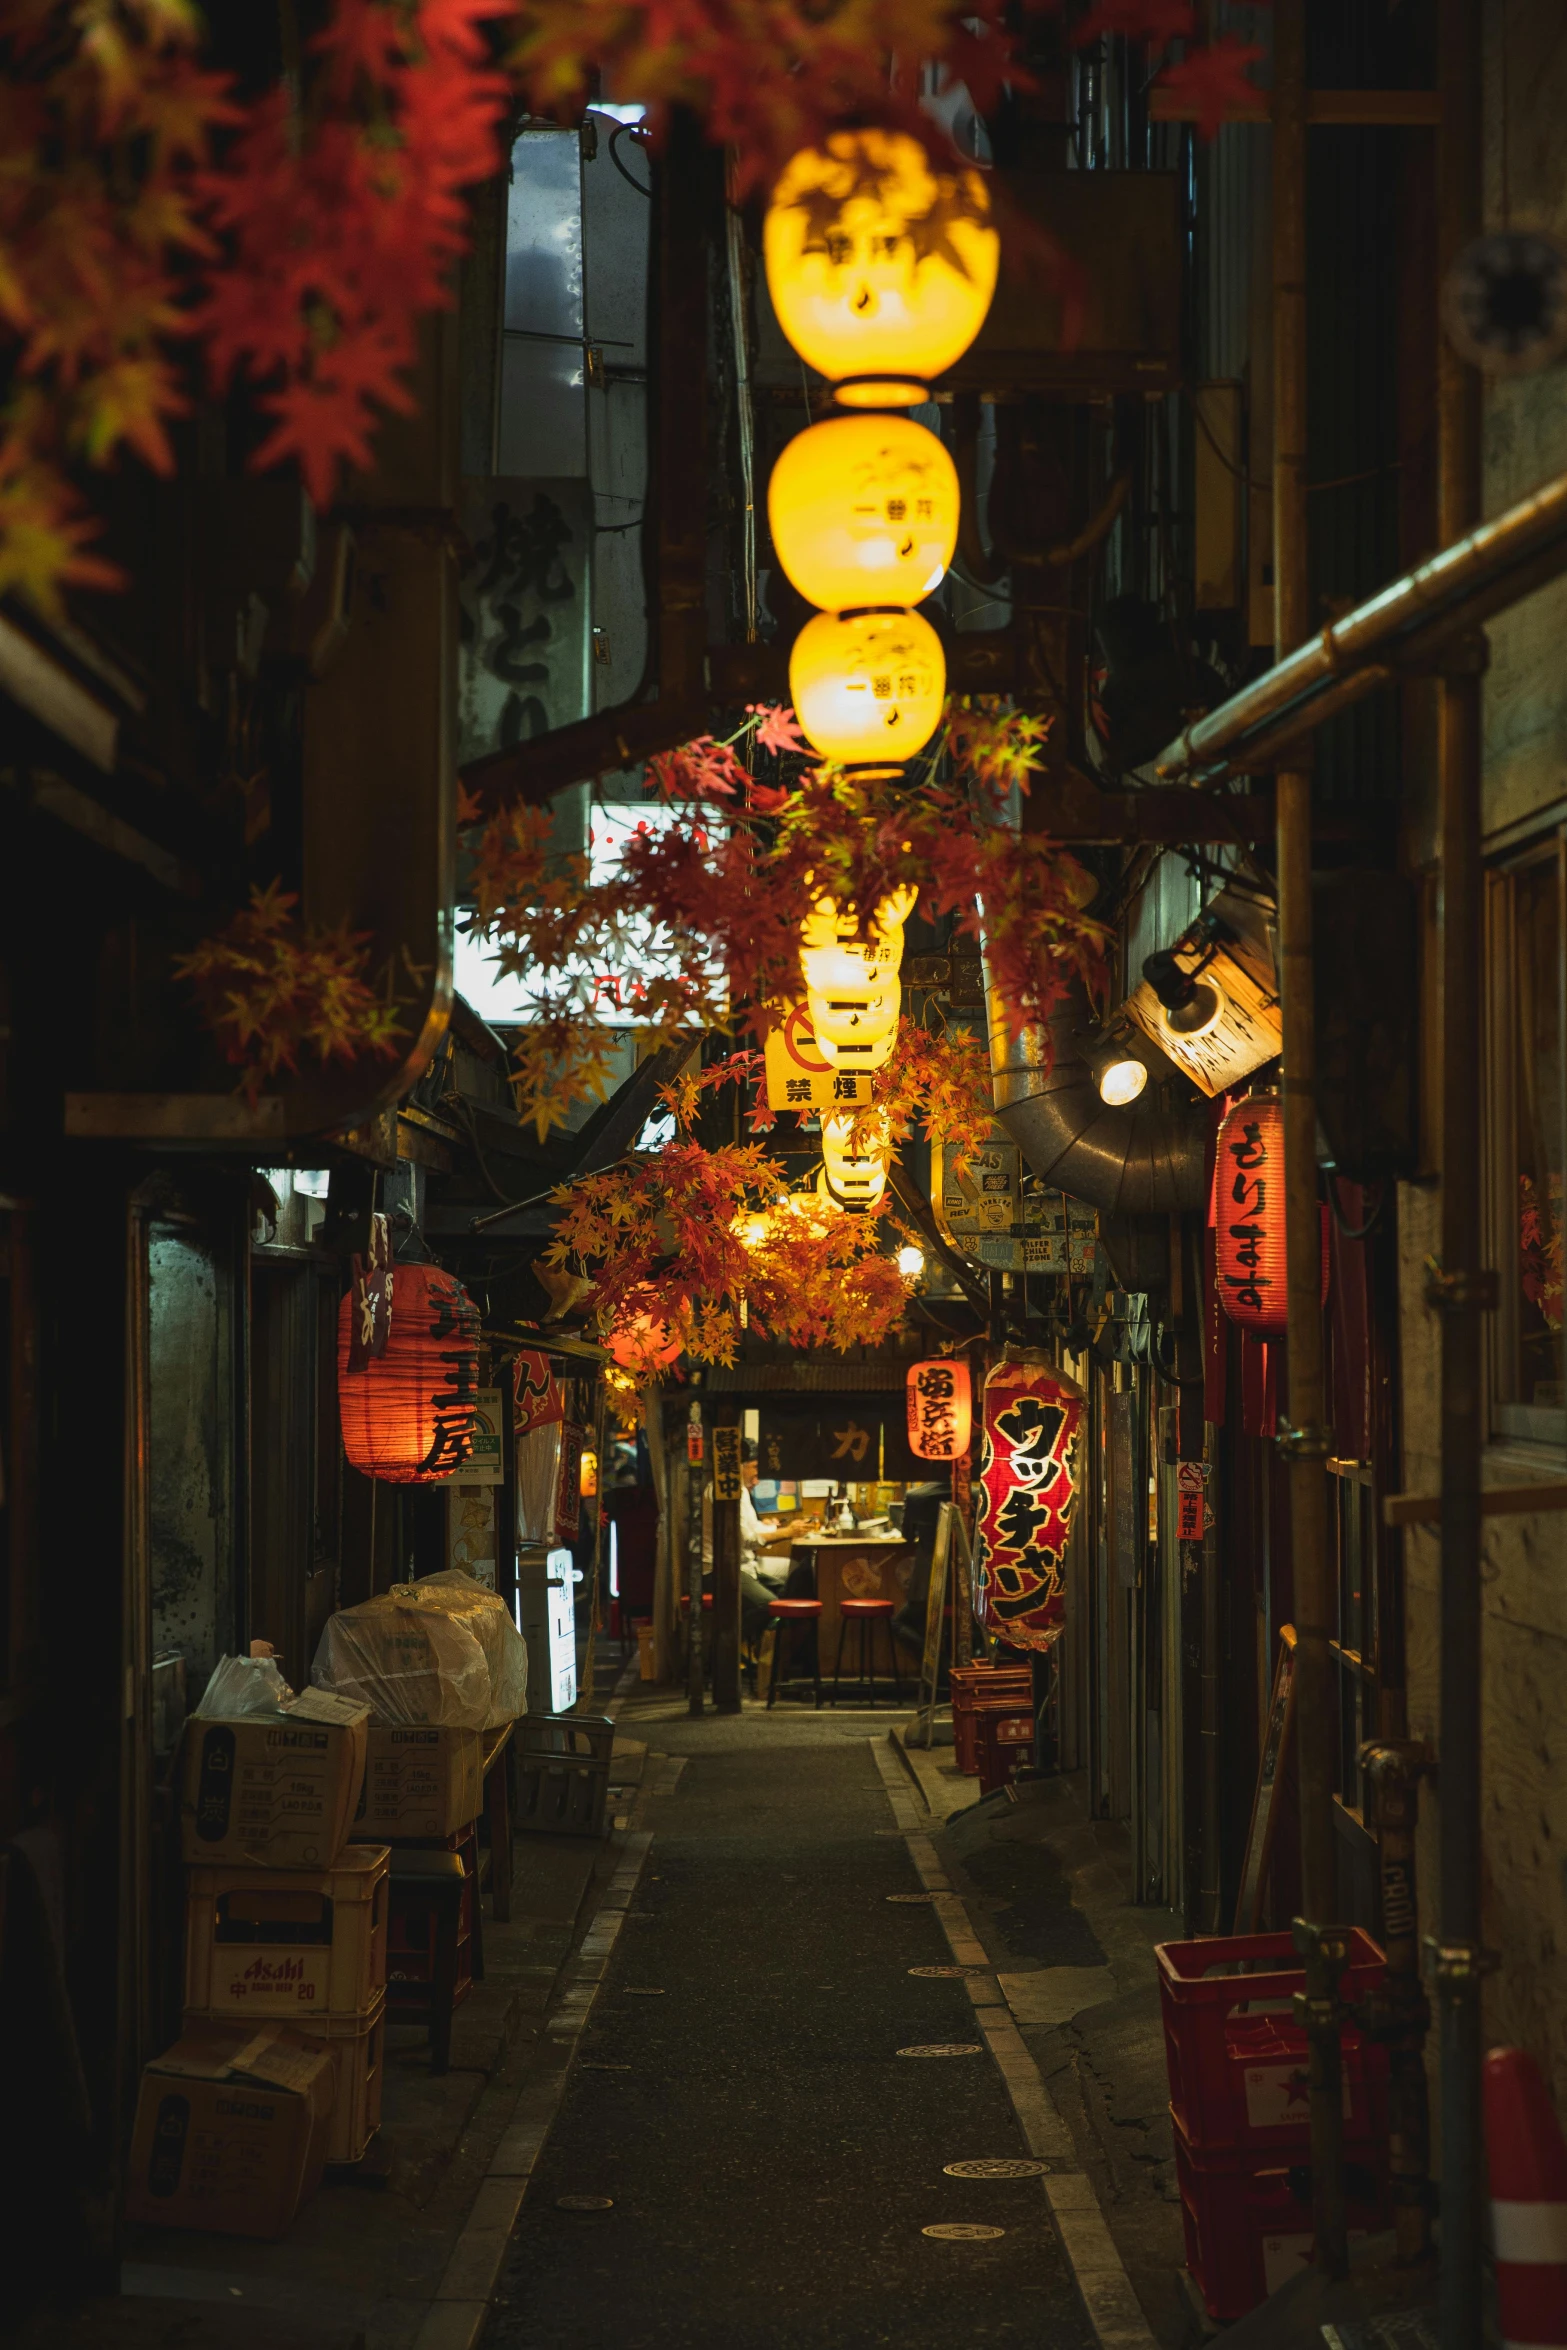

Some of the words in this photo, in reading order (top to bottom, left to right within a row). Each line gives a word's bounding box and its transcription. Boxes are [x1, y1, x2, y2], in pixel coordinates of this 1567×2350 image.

[785, 1076, 858, 1102] 禁煙
[716, 1429, 740, 1498] 営業中
[200, 1745, 229, 1823] 白炭
[244, 1956, 304, 1981] Asahi
[230, 1982, 247, 1999] 中
[297, 1983, 315, 2000] 20
